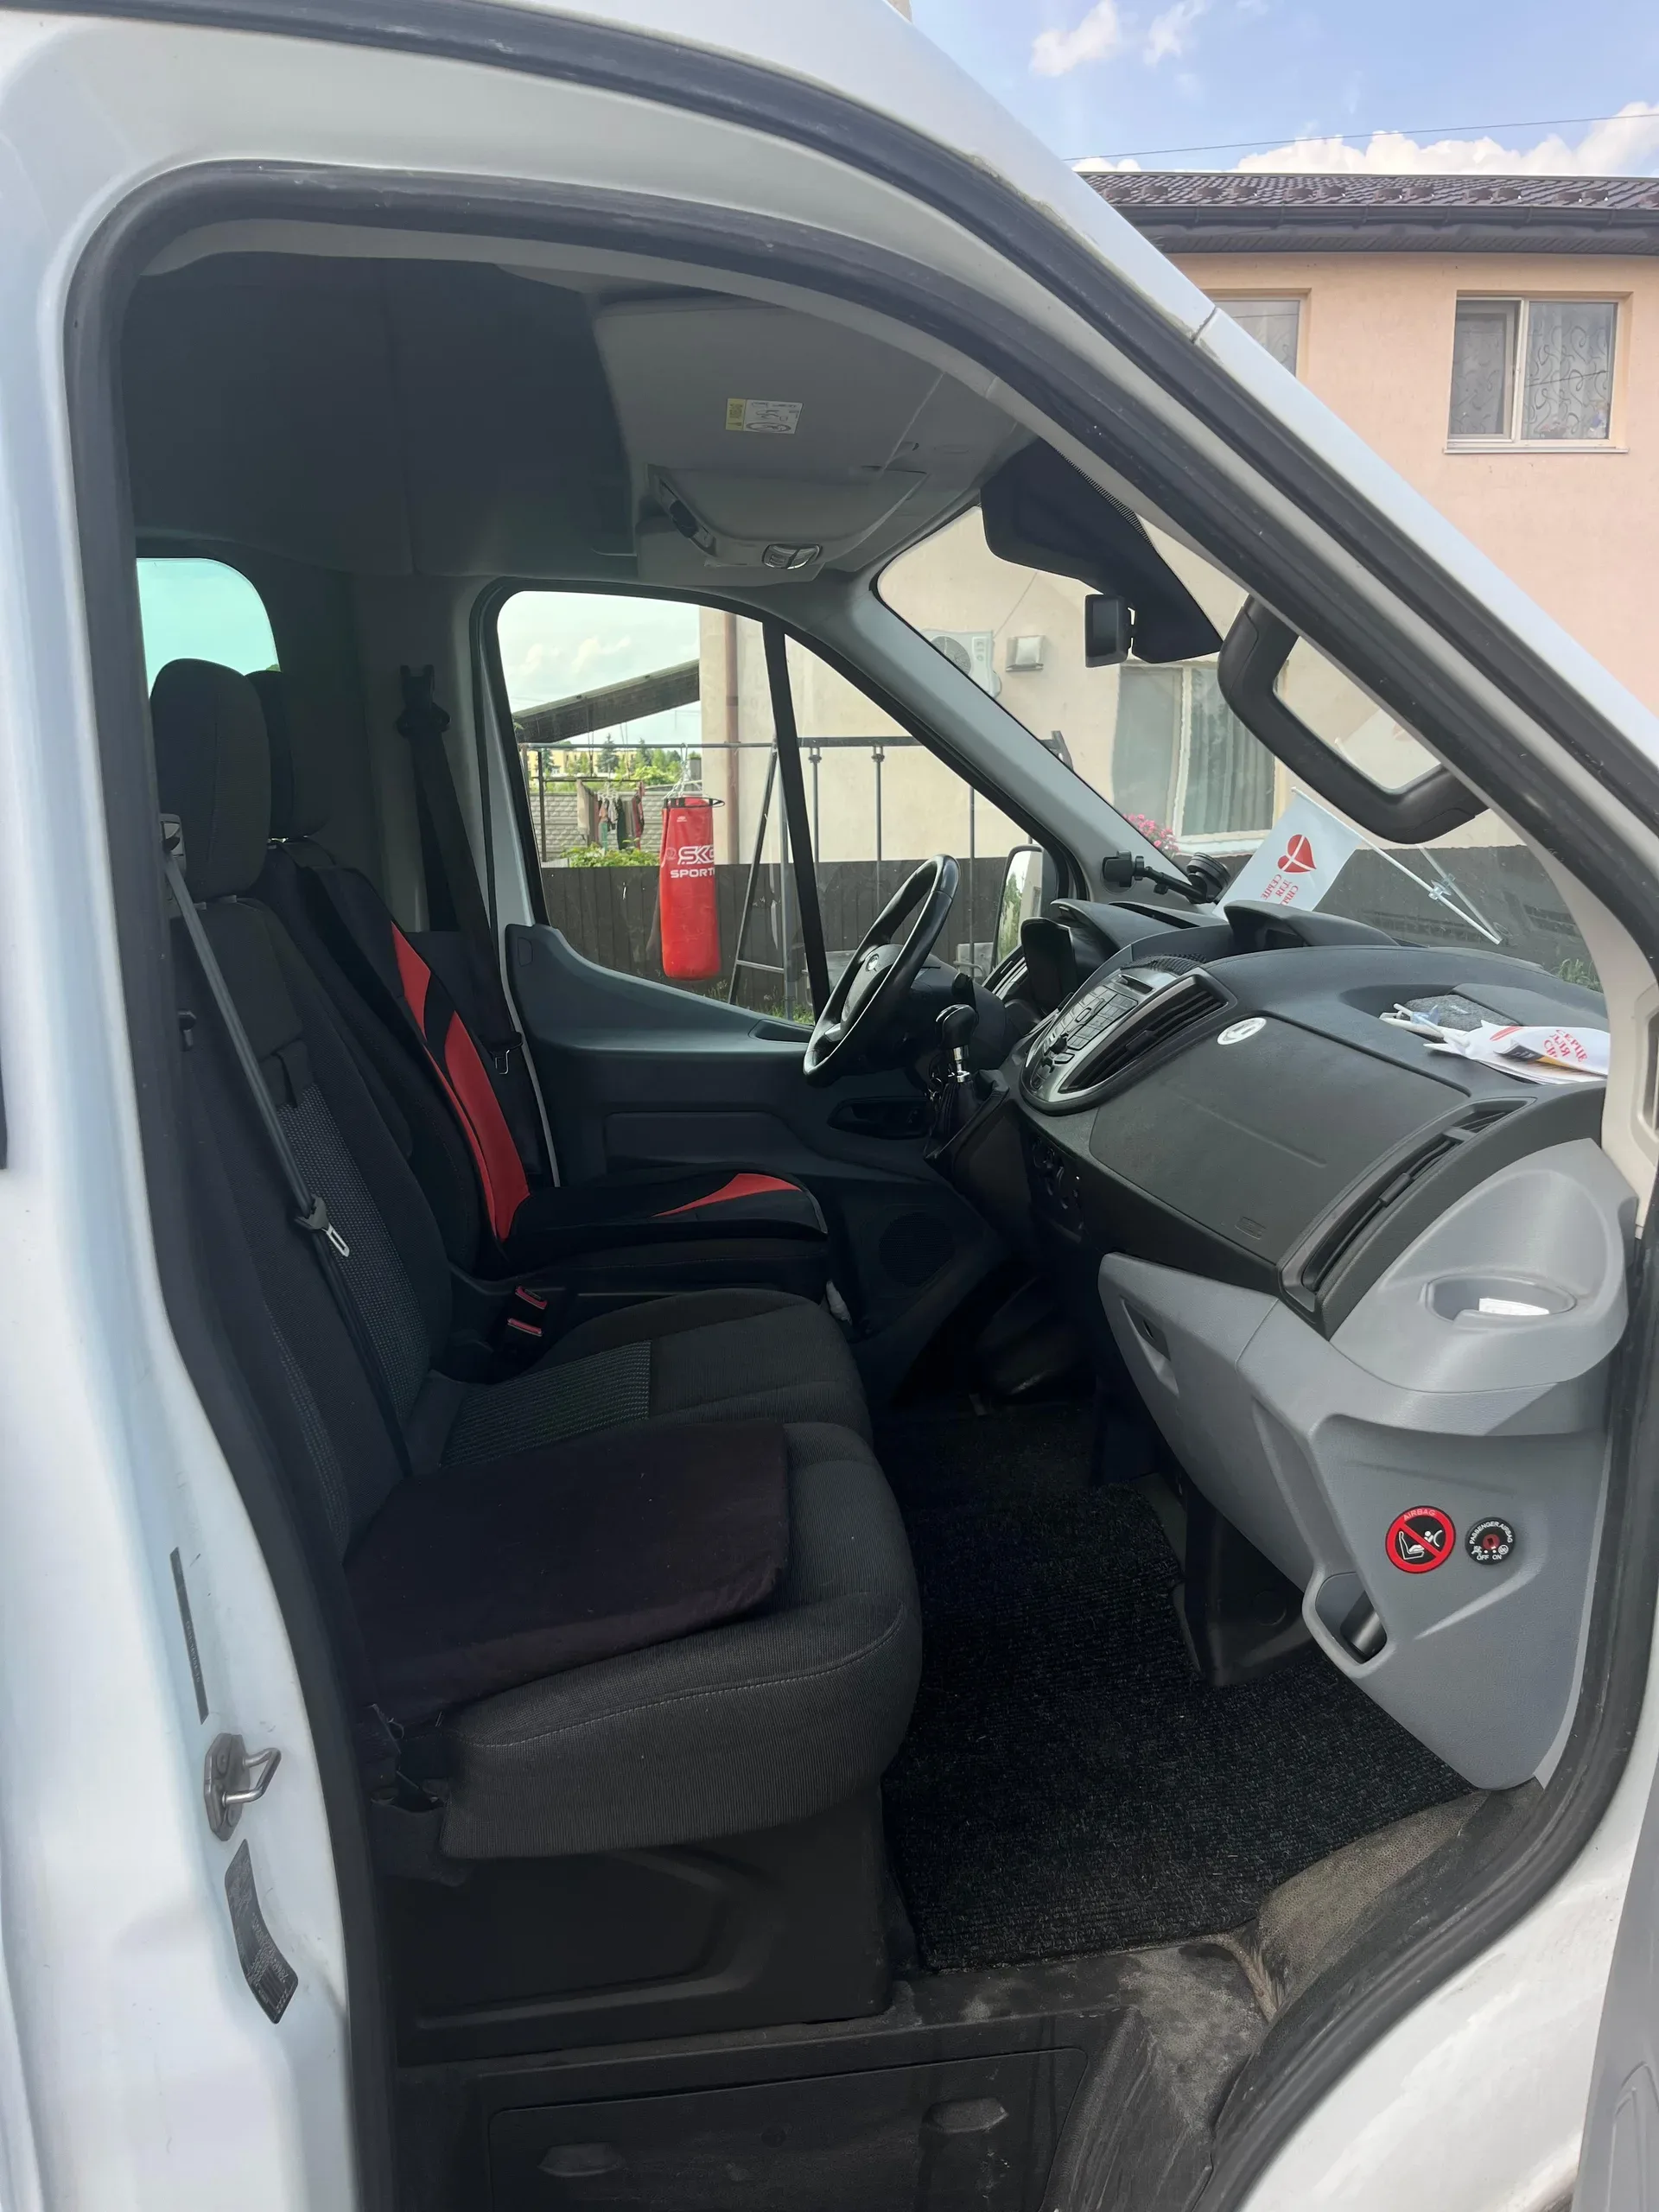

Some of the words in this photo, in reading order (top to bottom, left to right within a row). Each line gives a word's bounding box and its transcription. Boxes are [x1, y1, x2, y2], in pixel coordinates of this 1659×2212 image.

[1543, 1039, 1558, 1058] СИ
[1549, 1033, 1571, 1057] ДЛЯ
[1556, 1029, 1588, 1062] СЕРЦЕ
[1403, 1508, 1437, 1522] AIRBAG
[1470, 1521, 1499, 1544] PASSENGER
[1499, 1522, 1513, 1543] AIRBAG
